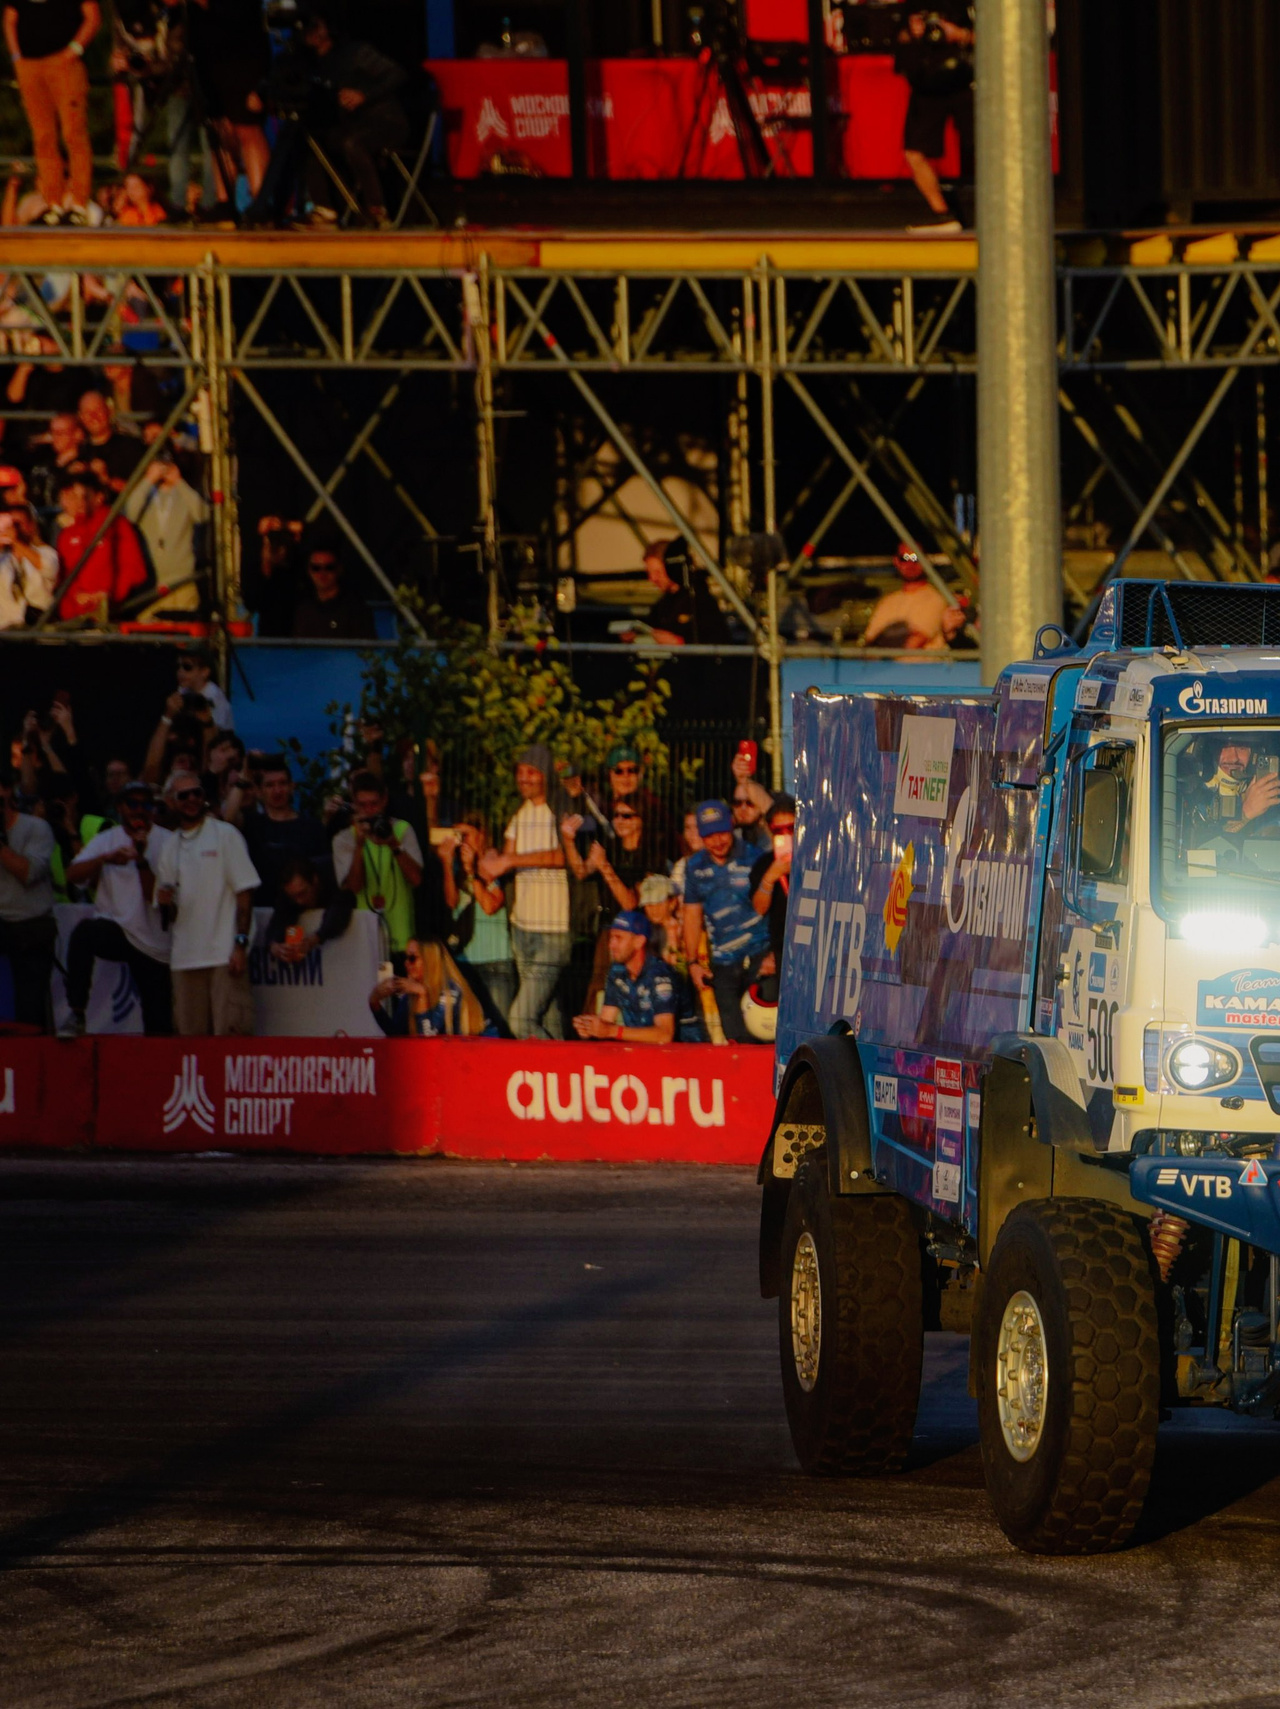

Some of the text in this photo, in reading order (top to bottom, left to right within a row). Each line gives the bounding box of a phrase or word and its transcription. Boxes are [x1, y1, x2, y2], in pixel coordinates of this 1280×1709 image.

[908, 775, 947, 802] TATNEFT
[815, 899, 866, 1017] VTB
[224, 1048, 377, 1096] МОСКОВСКИЙ
[224, 1097, 295, 1135] СПОРТ
[506, 1065, 726, 1128] auto.ru
[1180, 1174, 1233, 1198] VTB
